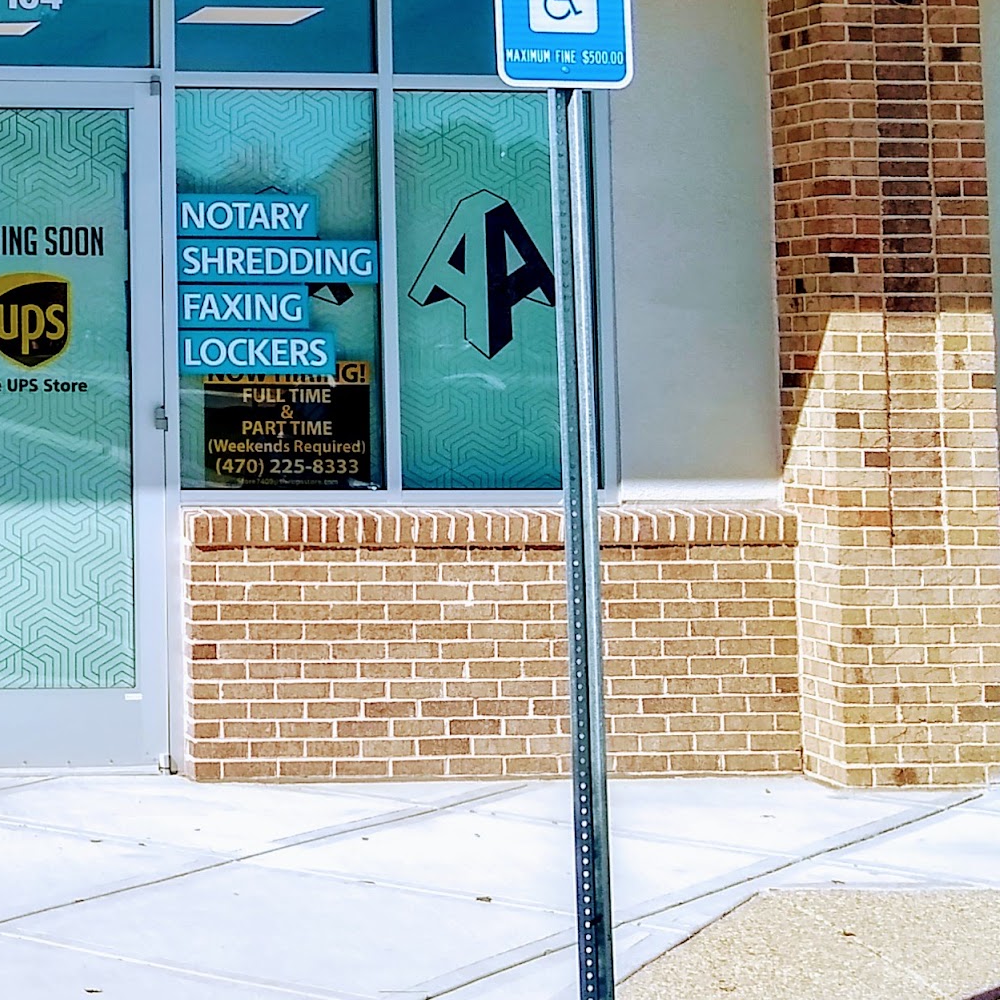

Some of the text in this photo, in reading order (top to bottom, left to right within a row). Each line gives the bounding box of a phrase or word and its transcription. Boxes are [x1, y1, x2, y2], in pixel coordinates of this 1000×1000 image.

[506, 48, 624, 65] MAXIMUM FINE $500.00
[180, 201, 310, 231] NOTARY
[45, 226, 105, 257] SOON
[182, 247, 373, 276] SHREDDING
[183, 293, 302, 321] FAXING
[184, 338, 328, 367] LOCKERS
[7, 378, 39, 393] UPS
[43, 378, 88, 393] Store
[242, 388, 332, 404] FULL TIME
[280, 404, 294, 420] &
[242, 421, 333, 436] PART TIME
[208, 439, 366, 456] (Weekends Required)
[215, 458, 359, 476] (470) 225-8333
